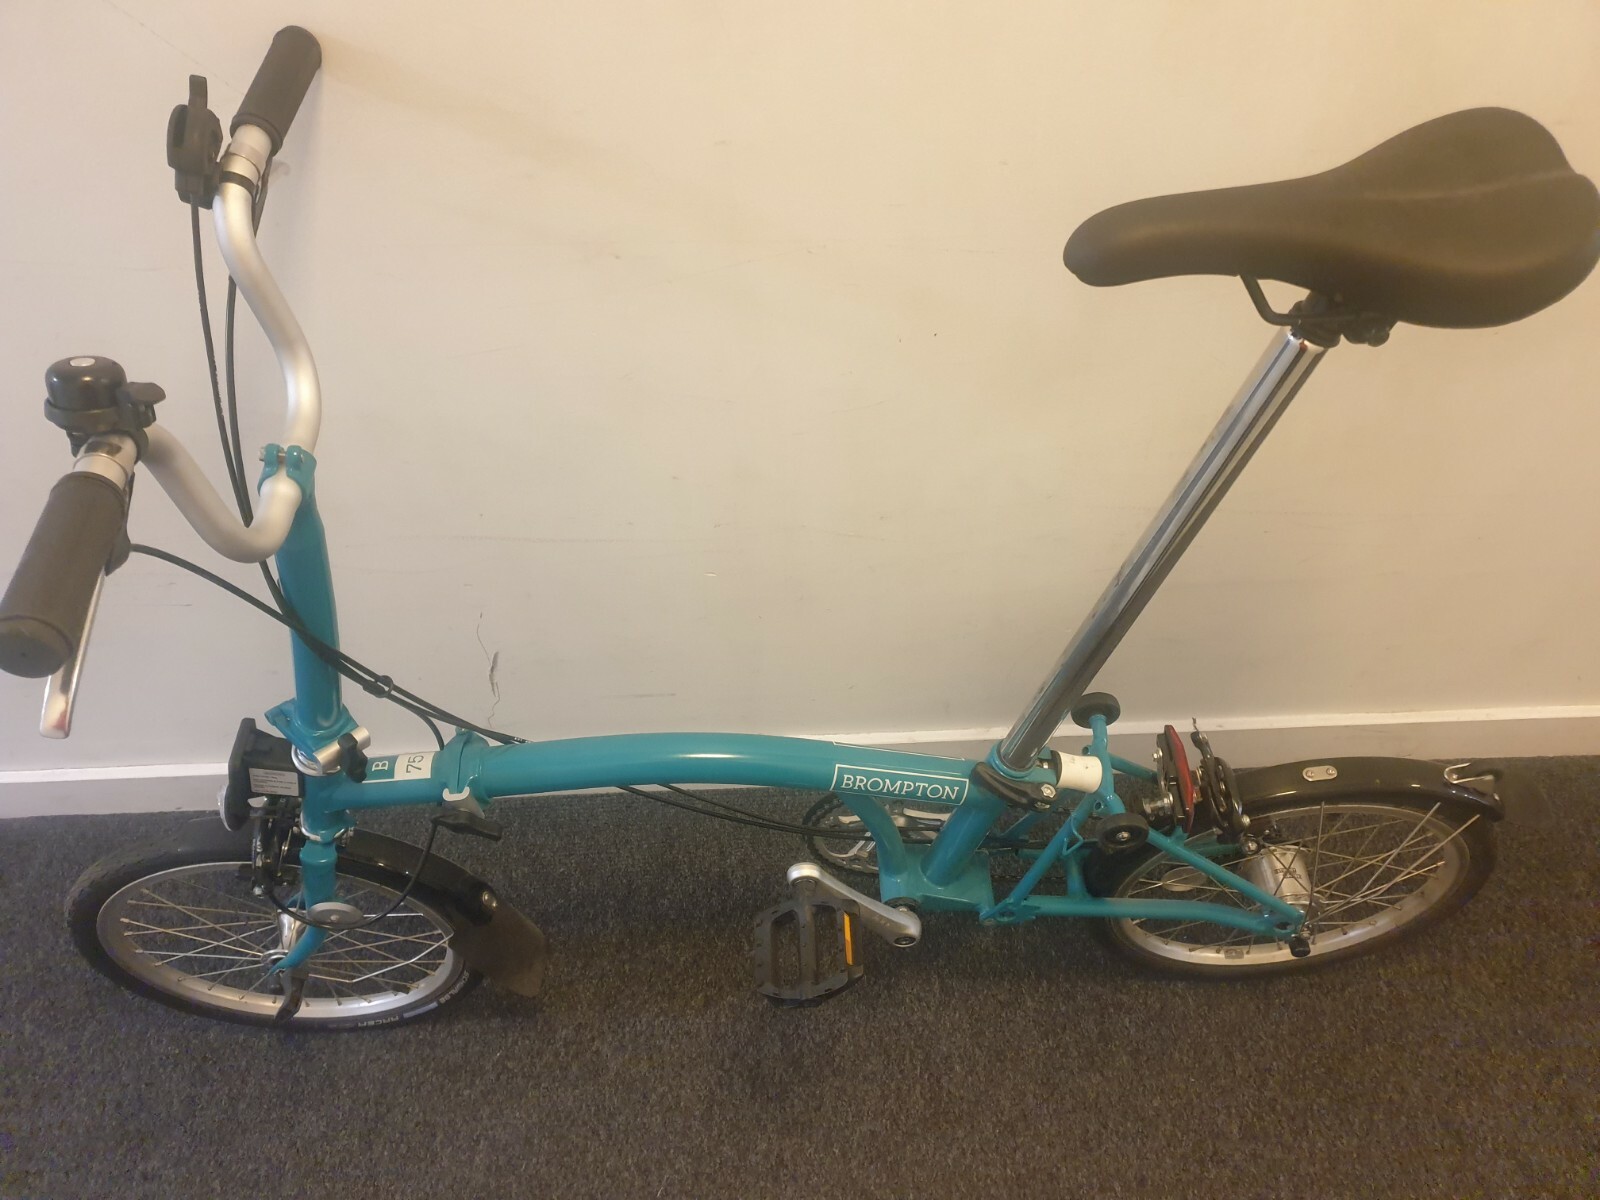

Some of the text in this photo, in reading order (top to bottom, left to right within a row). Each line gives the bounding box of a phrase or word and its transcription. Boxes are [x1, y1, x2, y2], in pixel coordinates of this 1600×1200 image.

[371, 760, 389, 772] B
[406, 754, 425, 774] 75
[841, 774, 960, 800] BROMPTON
